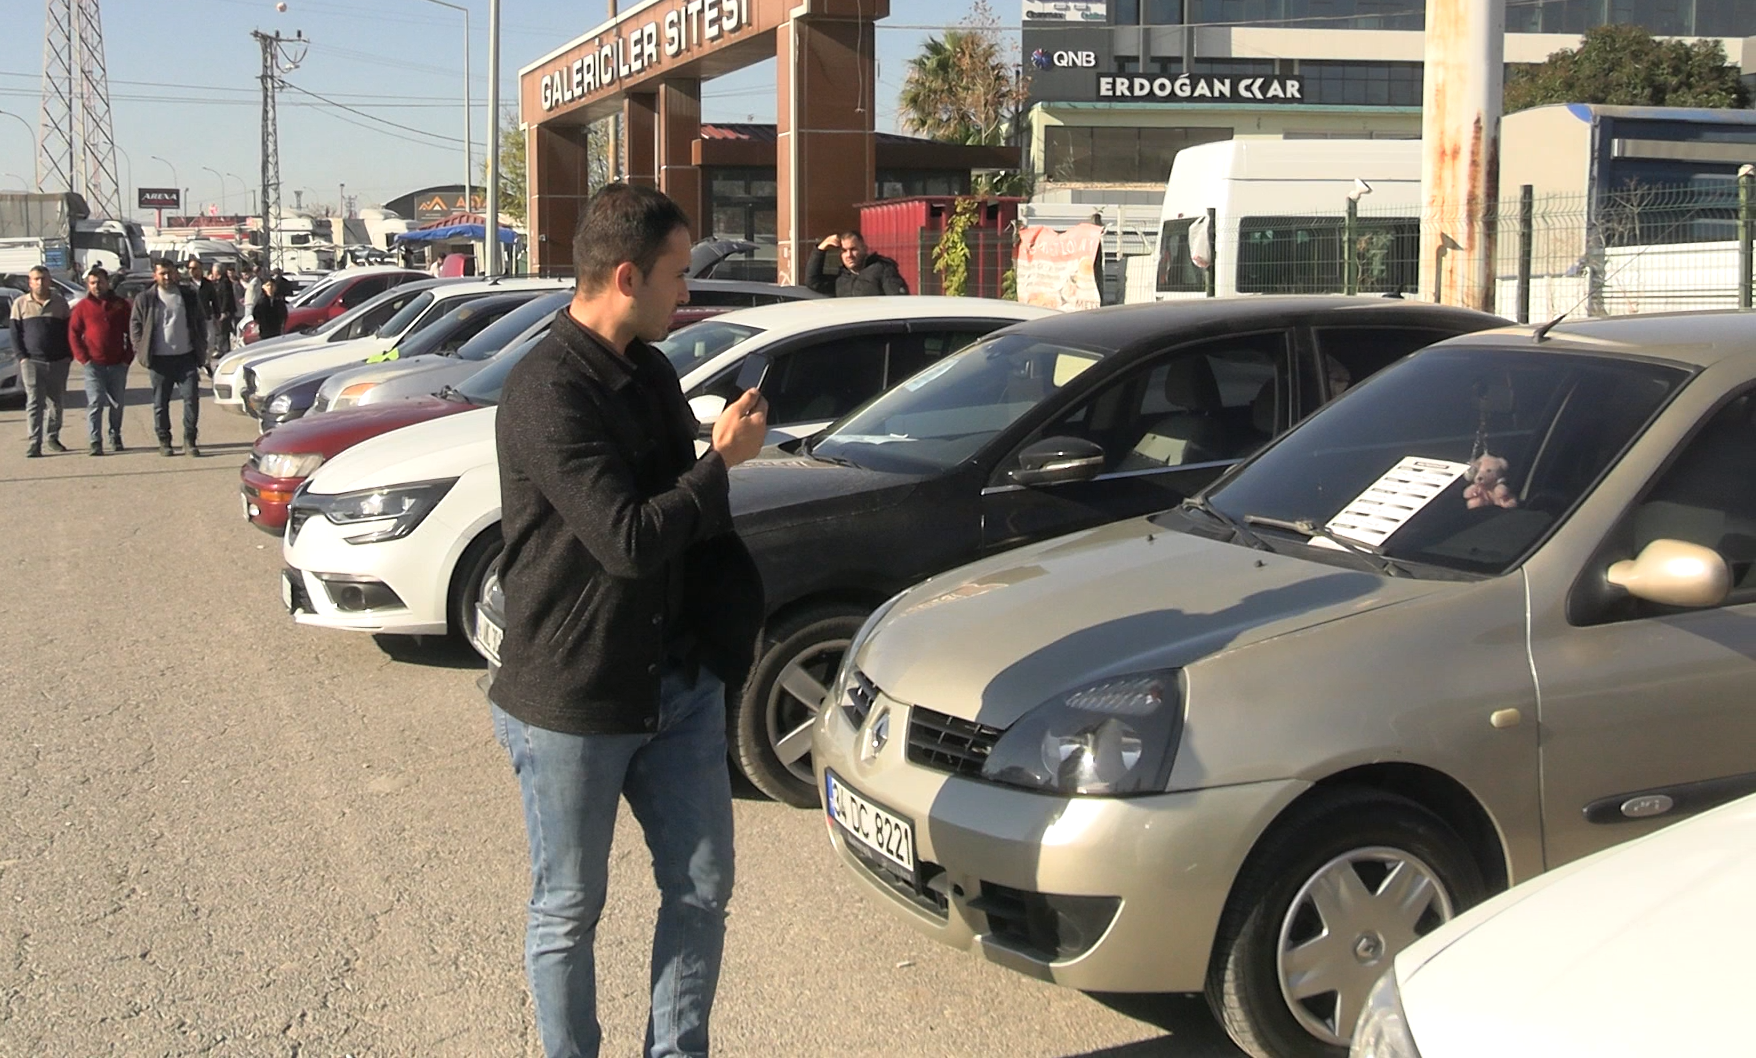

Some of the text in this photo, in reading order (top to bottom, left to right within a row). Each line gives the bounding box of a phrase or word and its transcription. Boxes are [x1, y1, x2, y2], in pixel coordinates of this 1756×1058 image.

[1053, 51, 1096, 67] QNB
[1100, 73, 1231, 98] ERDOĞAN
[832, 783, 848, 820] 34
[850, 796, 869, 839] DC
[875, 812, 911, 866] 8221
